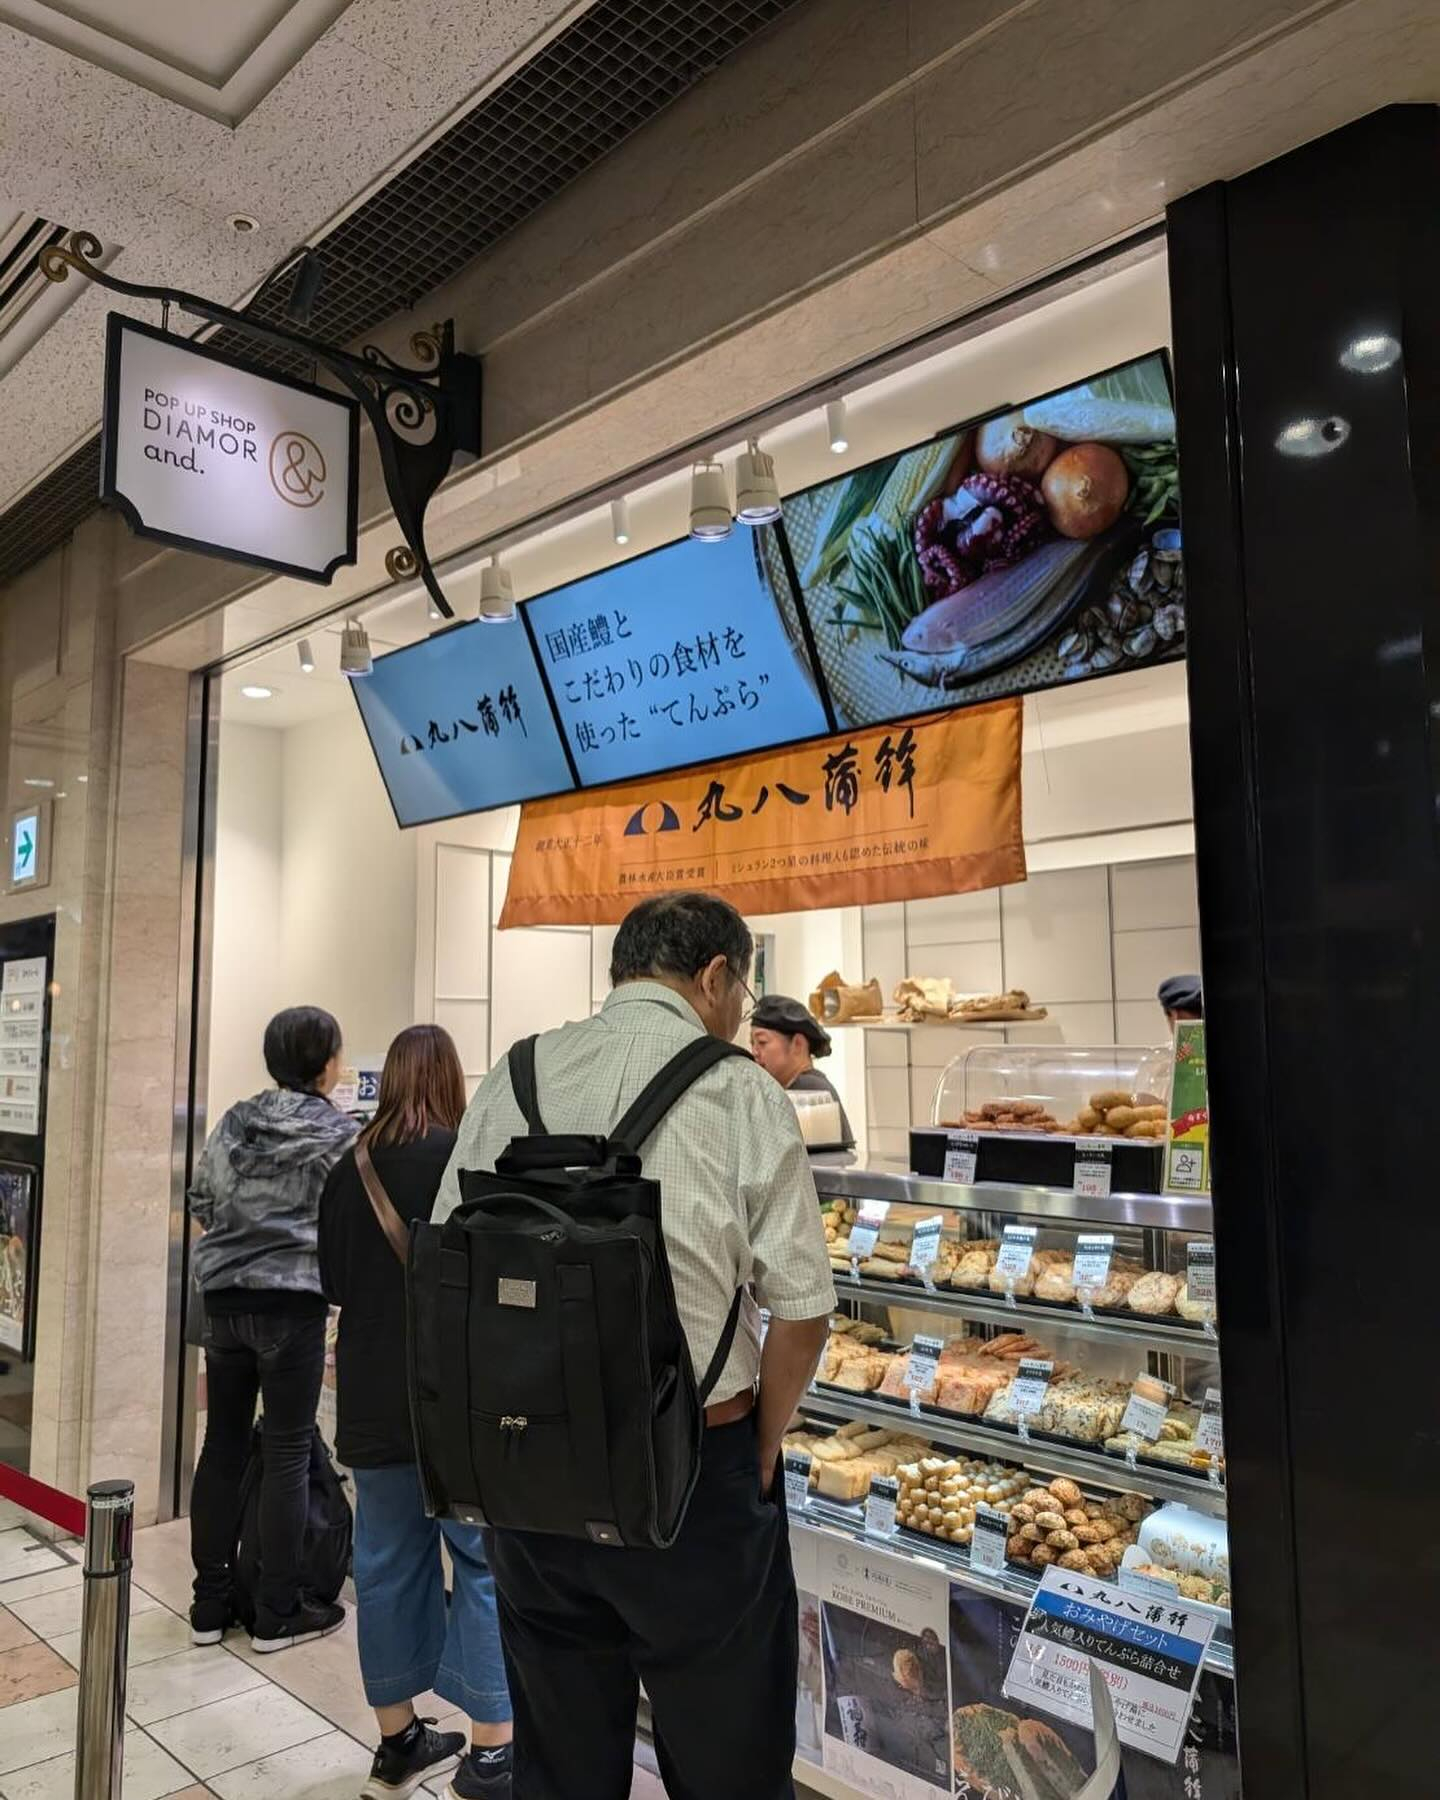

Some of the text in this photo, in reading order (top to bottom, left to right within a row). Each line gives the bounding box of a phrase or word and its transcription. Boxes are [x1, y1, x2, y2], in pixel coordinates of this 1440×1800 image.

[143, 408, 258, 463] DIAMOR
[144, 388, 256, 434] POP UP SHOP
[143, 444, 205, 475] and.
[545, 610, 632, 663] 国産鱧と
[564, 626, 746, 704] こだわりの食材を
[693, 728, 918, 832] 丸八蒲鉾
[1063, 1602, 1168, 1650] おみやげセット
[1092, 1591, 1189, 1636] 丸八蒲鉾
